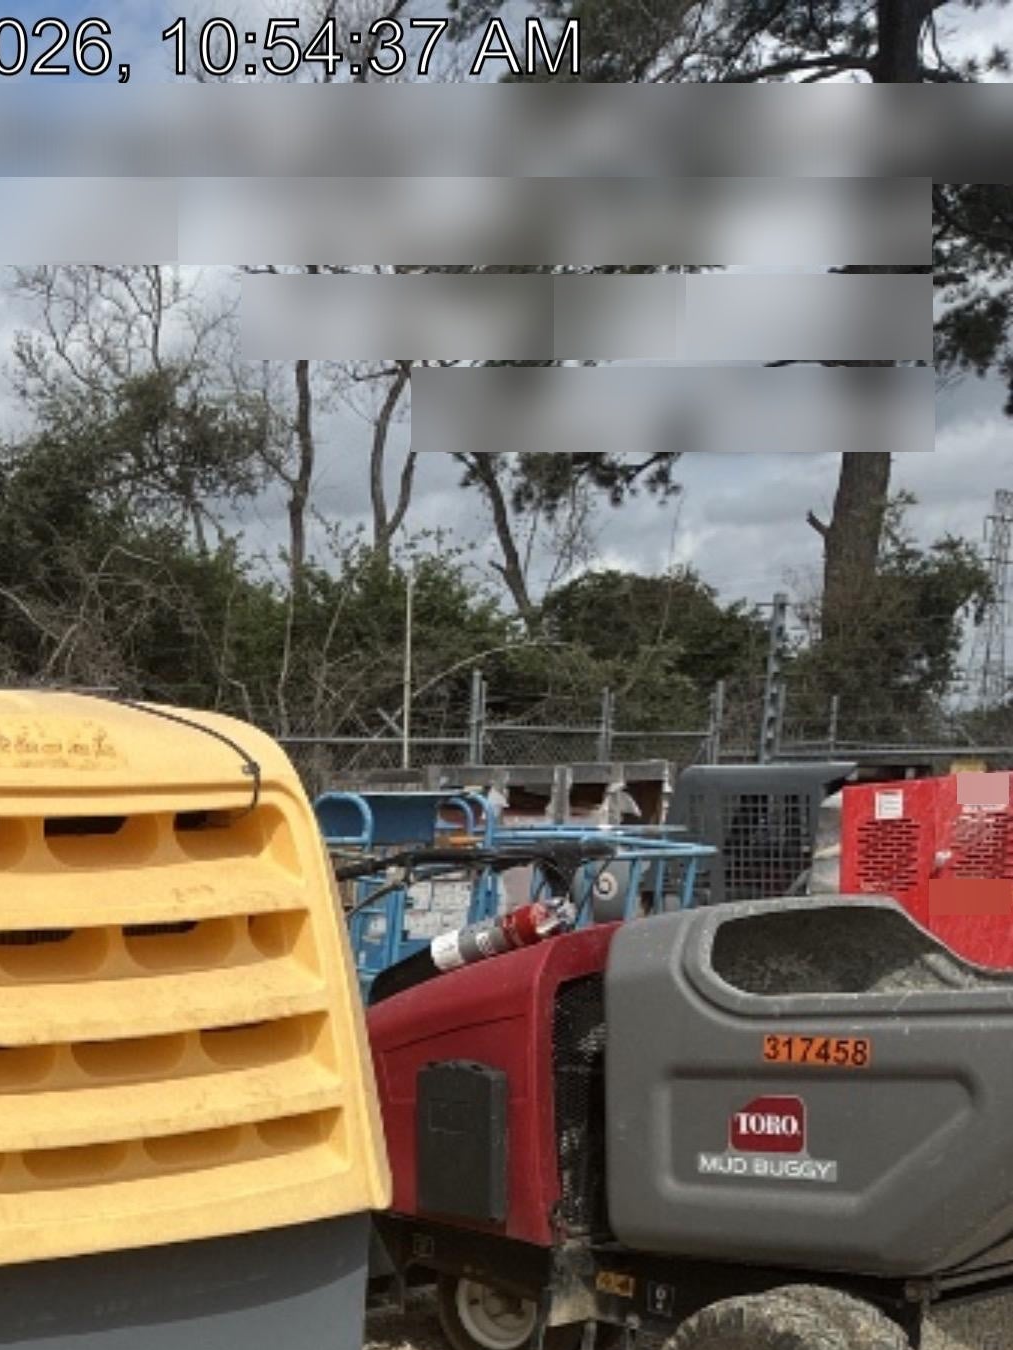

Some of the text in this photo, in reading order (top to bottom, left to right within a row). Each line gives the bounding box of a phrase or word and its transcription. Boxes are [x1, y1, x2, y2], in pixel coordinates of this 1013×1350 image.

[764, 1034, 868, 1066] 317458
[734, 1112, 799, 1136] TORO
[699, 1154, 831, 1180] MUD BUGGY
